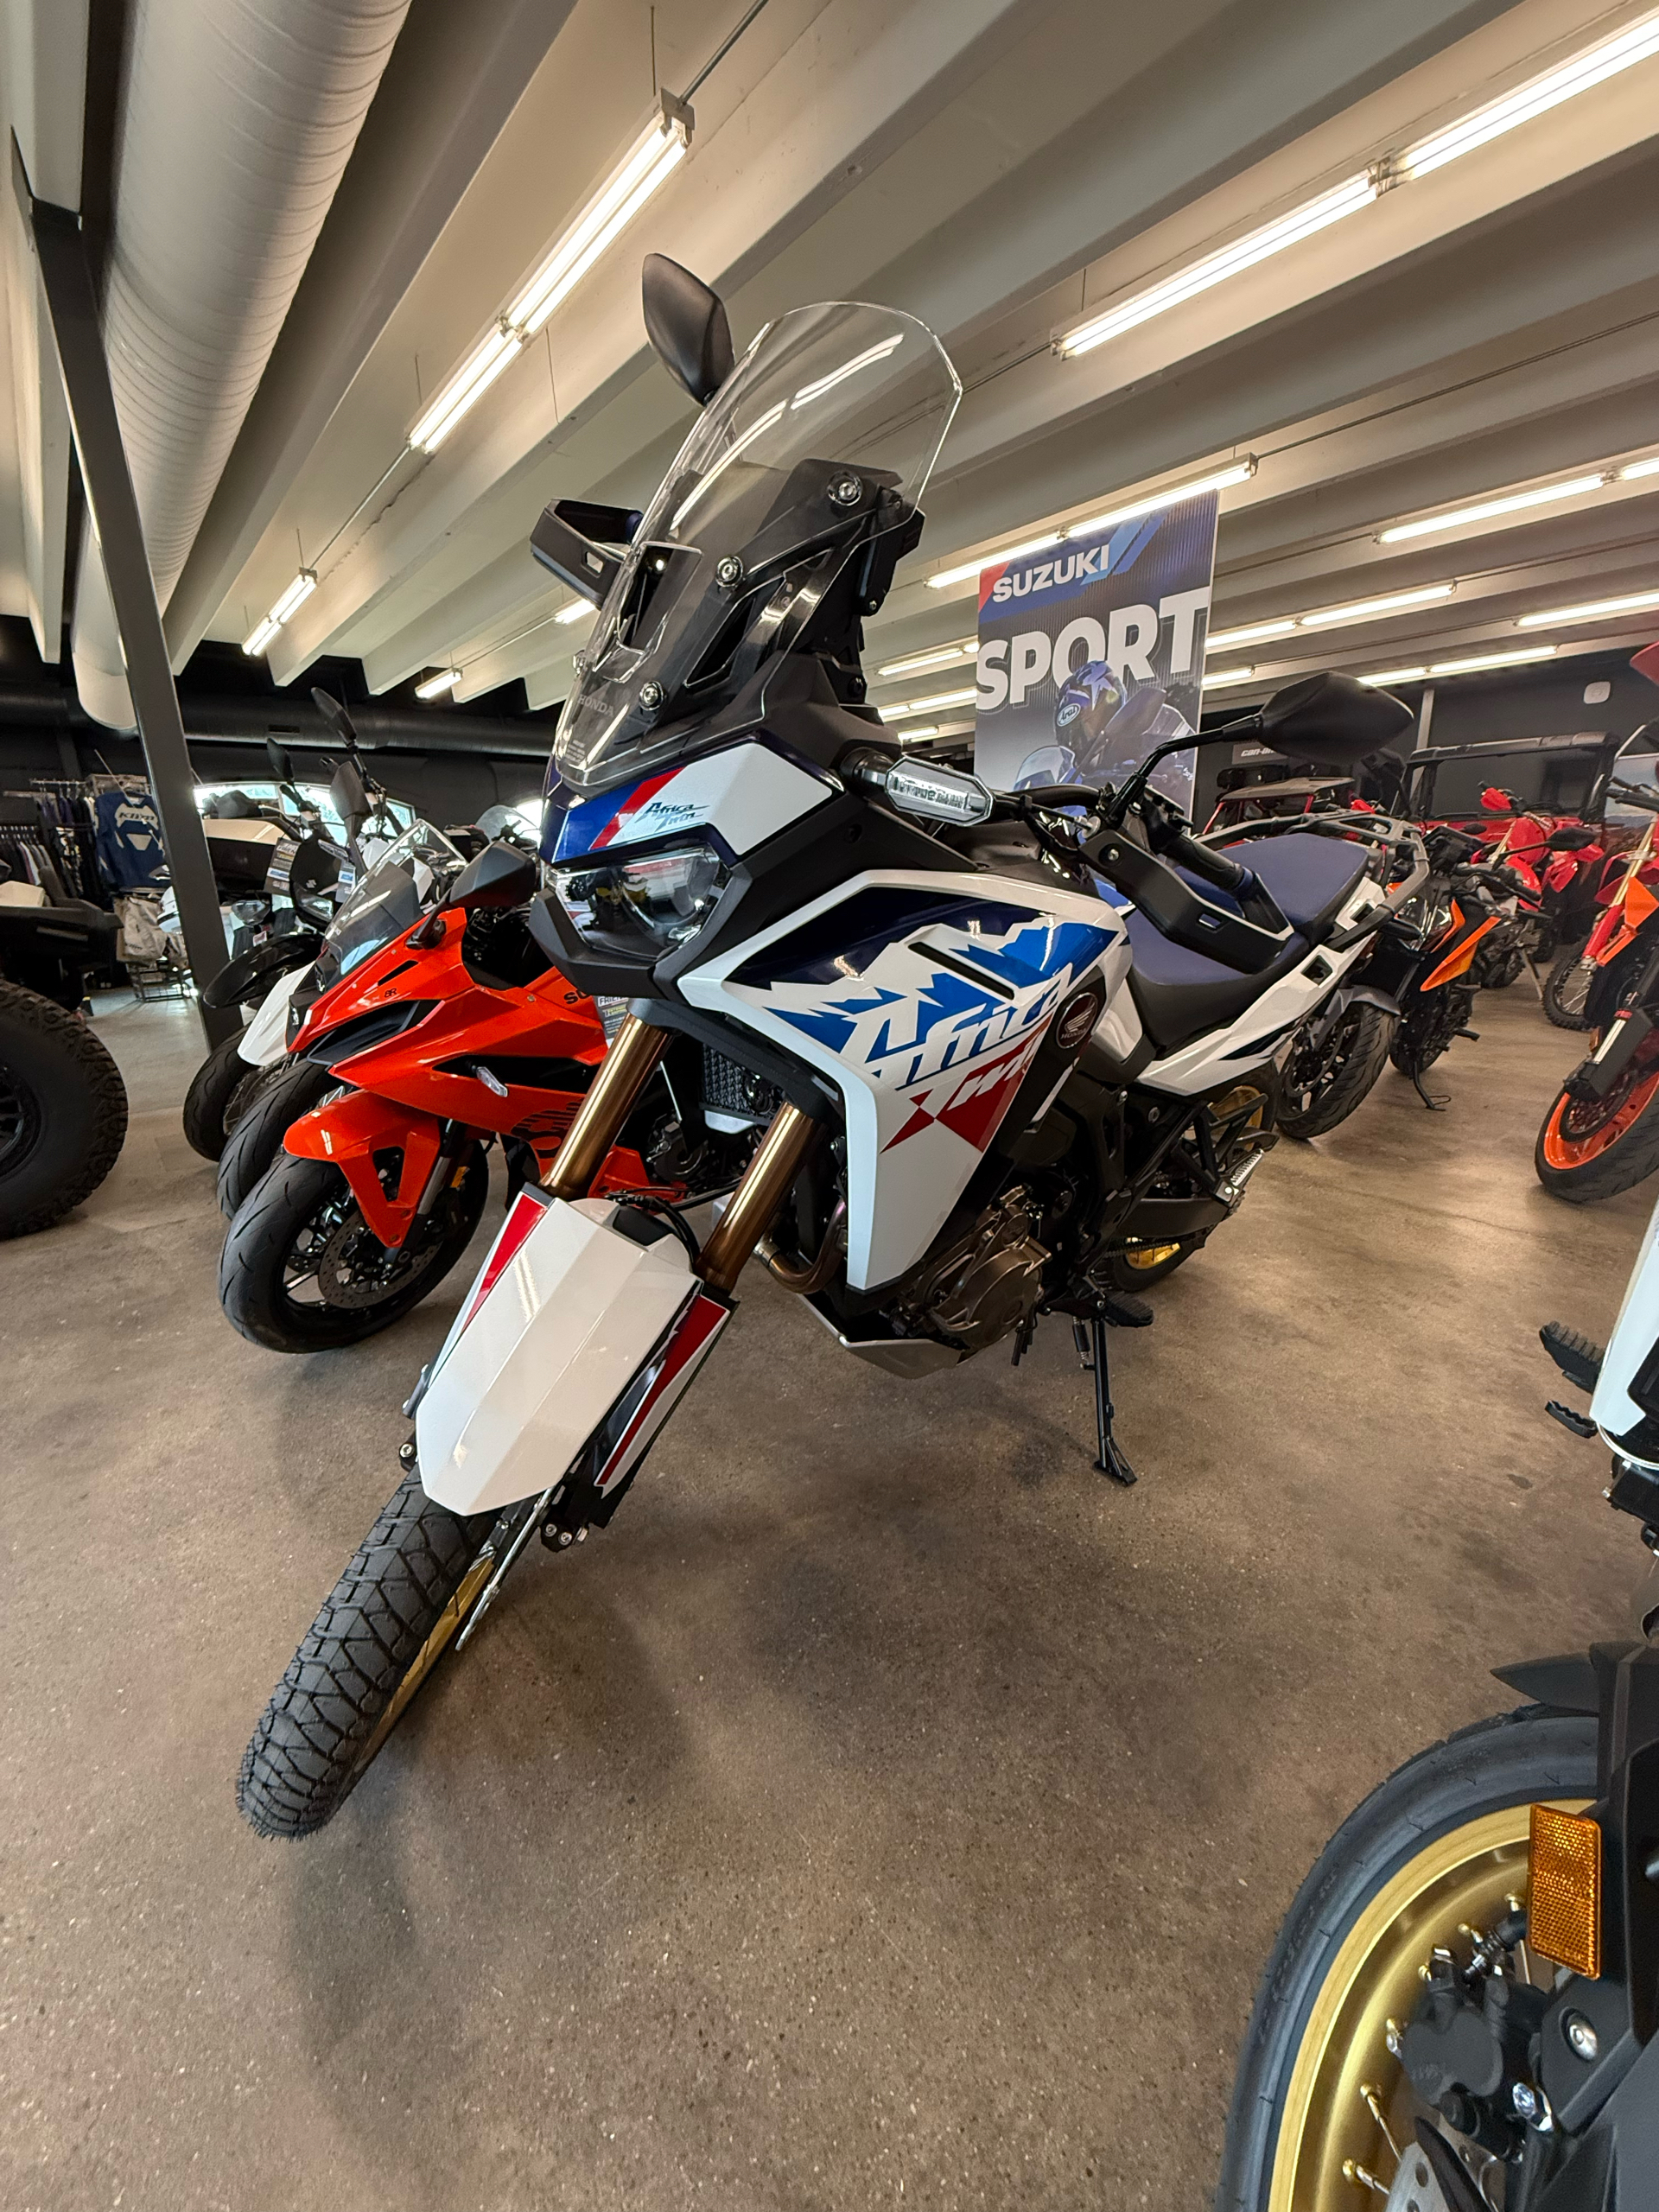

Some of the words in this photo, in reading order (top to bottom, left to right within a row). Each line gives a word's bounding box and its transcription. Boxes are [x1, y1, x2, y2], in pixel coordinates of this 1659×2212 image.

[993, 543, 1109, 603] SUZUKI
[976, 586, 1211, 711] SPORT
[577, 693, 614, 717] HONDA
